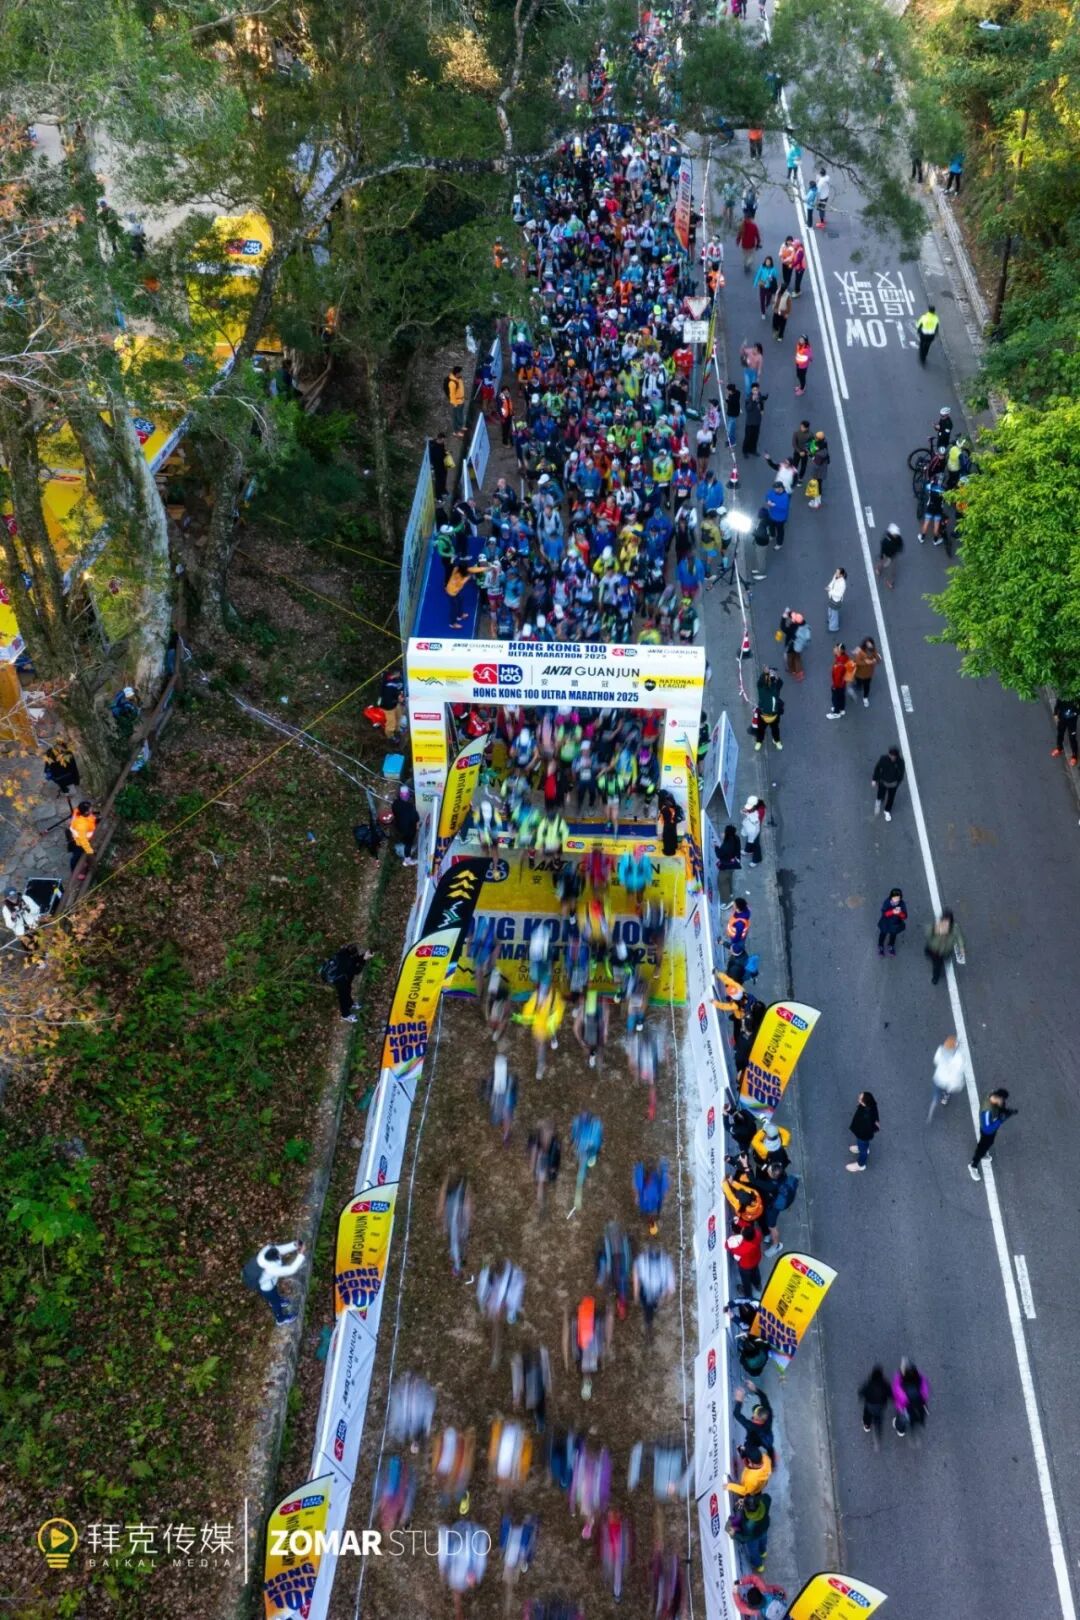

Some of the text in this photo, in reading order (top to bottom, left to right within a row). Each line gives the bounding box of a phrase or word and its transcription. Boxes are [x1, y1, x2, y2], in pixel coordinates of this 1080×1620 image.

[508, 642, 543, 651] HONG
[547, 643, 581, 652] KONG
[584, 645, 607, 653] 100
[501, 667, 520, 675] HK
[542, 665, 640, 678] ANTA GUANJUN
[473, 688, 639, 702] HONG KONG 100 ULTRA MARATHON 2025
[404, 960, 428, 1018] ANTA GUANJUN
[387, 1021, 428, 1035] HONG
[389, 1031, 428, 1048] KONG
[767, 1022, 787, 1054] GUANJUN
[390, 1042, 428, 1064] 100
[747, 1069, 782, 1099] KONG
[748, 1060, 781, 1085] HONG
[747, 1080, 781, 1109] 100
[350, 1215, 368, 1265] ANTA GUANJUN
[335, 1268, 379, 1284] HONG
[338, 1278, 381, 1295] KONG
[781, 1272, 803, 1304] GUANJUN
[759, 1307, 797, 1338] HONG
[759, 1316, 798, 1345] KONG
[264, 1563, 315, 1590] HONG
